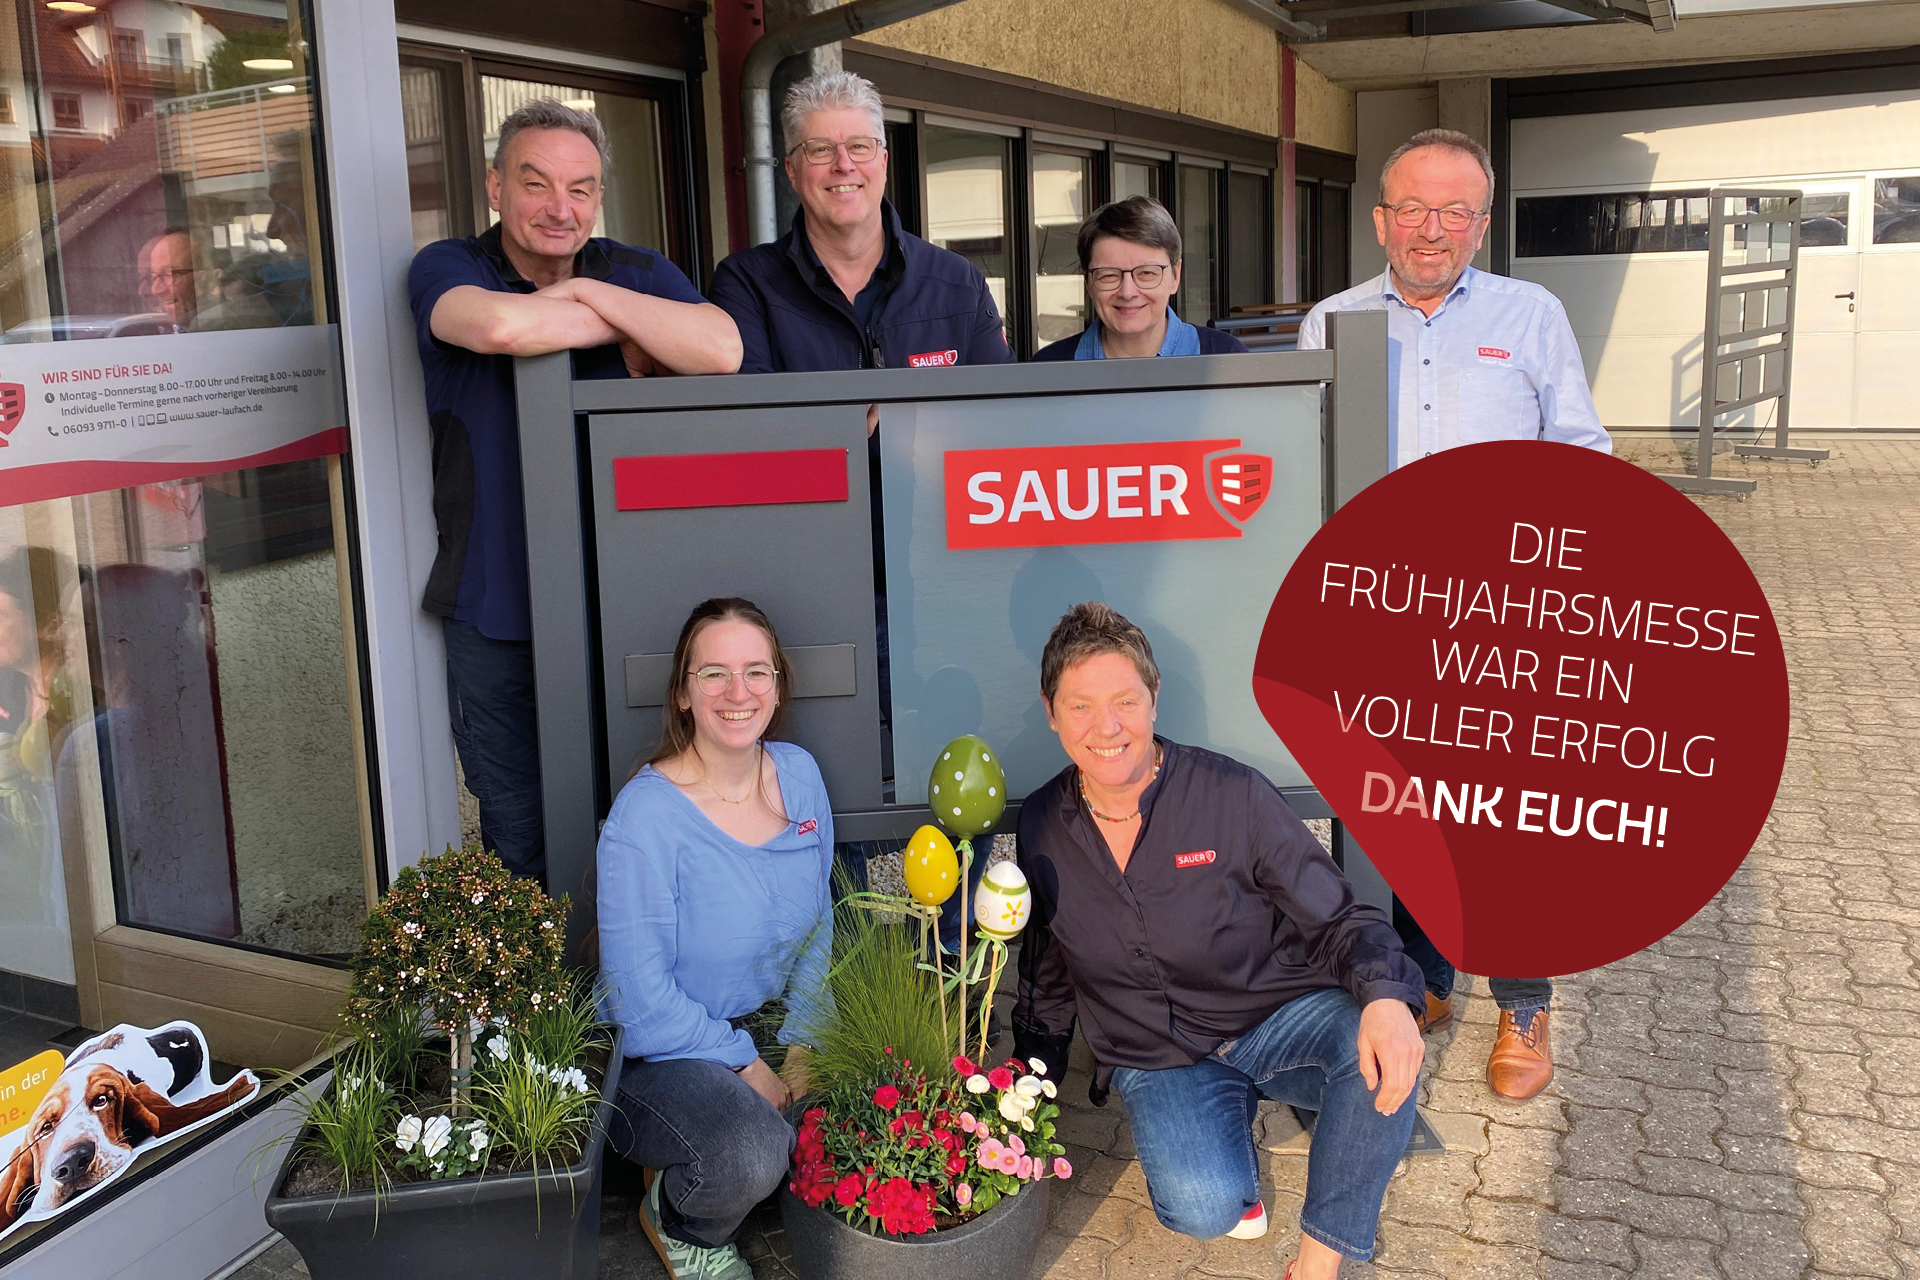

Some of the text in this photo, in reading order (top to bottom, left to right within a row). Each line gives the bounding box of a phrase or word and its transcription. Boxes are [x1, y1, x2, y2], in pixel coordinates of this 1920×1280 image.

[42, 362, 173, 384] WIR SIND FÜR SIE DA!
[912, 354, 945, 368] SAUER
[207, 377, 222, 387] Uhr
[224, 376, 240, 386] und
[241, 373, 268, 384] Freitag
[313, 367, 326, 377] Uhr
[61, 384, 298, 416] Individuelle Termine gerne nach vorheriger Vereinbarung
[63, 422, 95, 435] 06093
[97, 418, 127, 430] 9711-0
[169, 403, 262, 421] www.sauer-laufach.de
[966, 464, 1191, 525] SAUER
[1178, 853, 1205, 864] SAUER
[0, 1068, 48, 1101] in der
